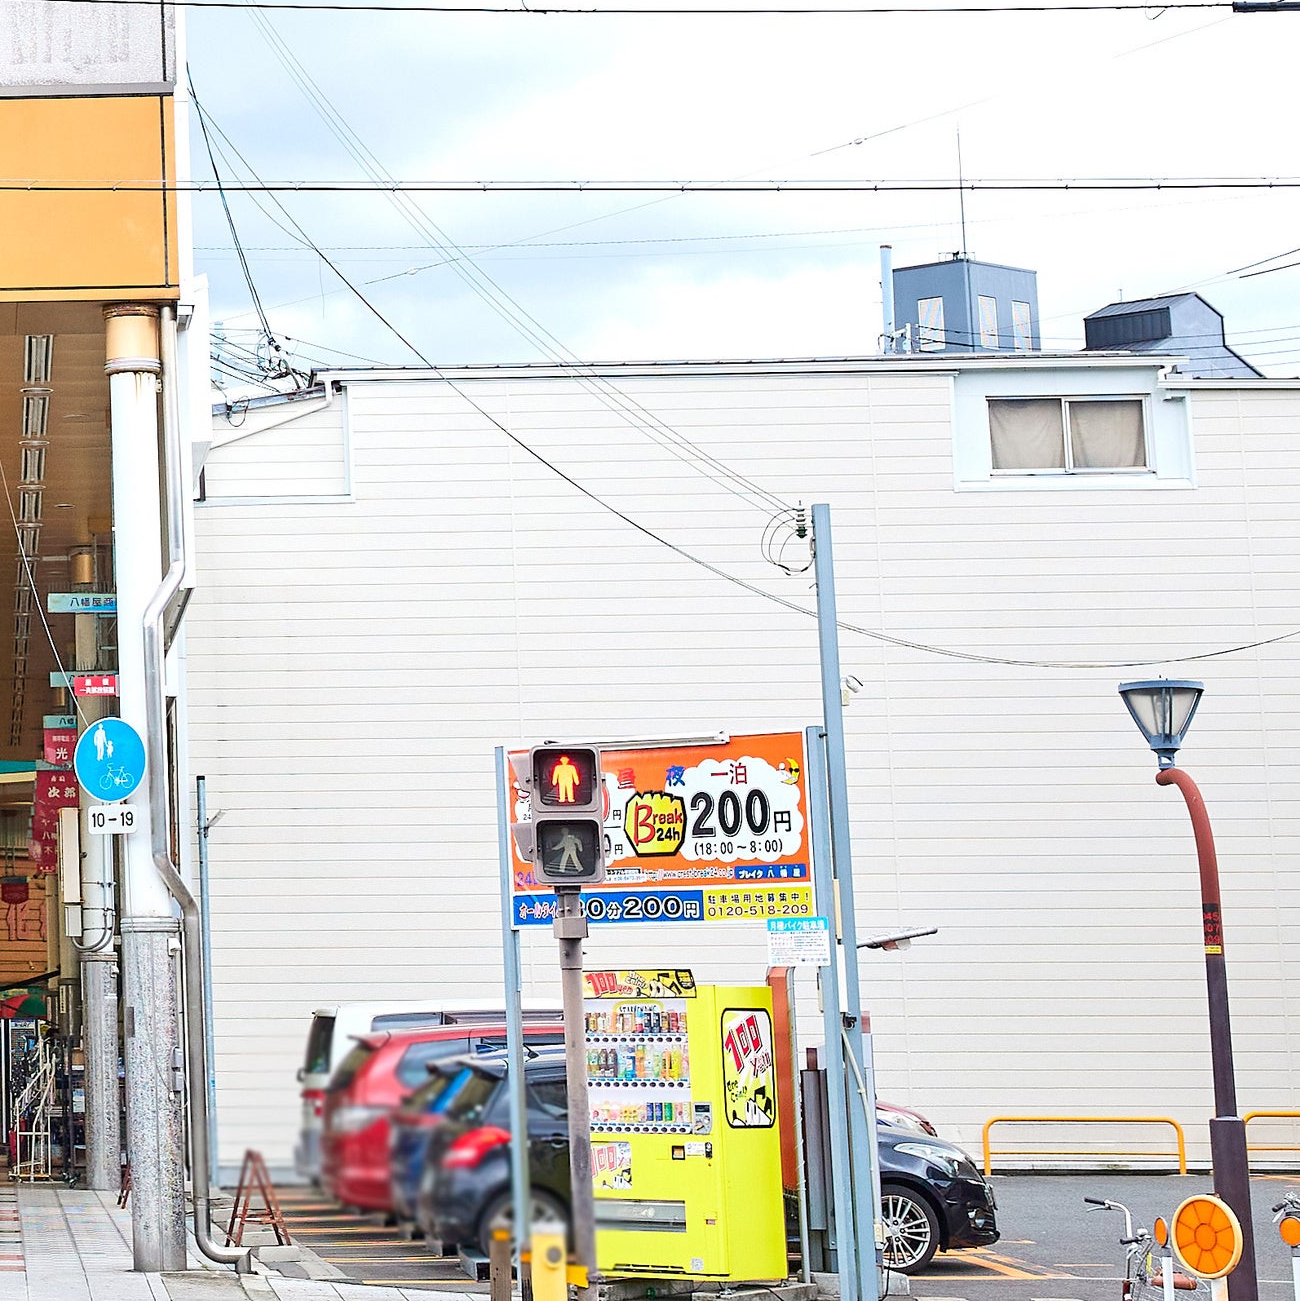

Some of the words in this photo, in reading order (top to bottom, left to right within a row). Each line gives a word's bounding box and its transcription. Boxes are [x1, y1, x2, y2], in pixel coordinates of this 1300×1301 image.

[56, 747, 68, 760] 光
[665, 764, 685, 787] 夜
[710, 762, 748, 785] 一泊
[634, 802, 683, 847] Break
[690, 788, 792, 838] 200円
[656, 826, 681, 842] 24h
[519, 902, 558, 920] オールタイ
[708, 904, 809, 917] 0120-518-209
[725, 1014, 763, 1074] 100
